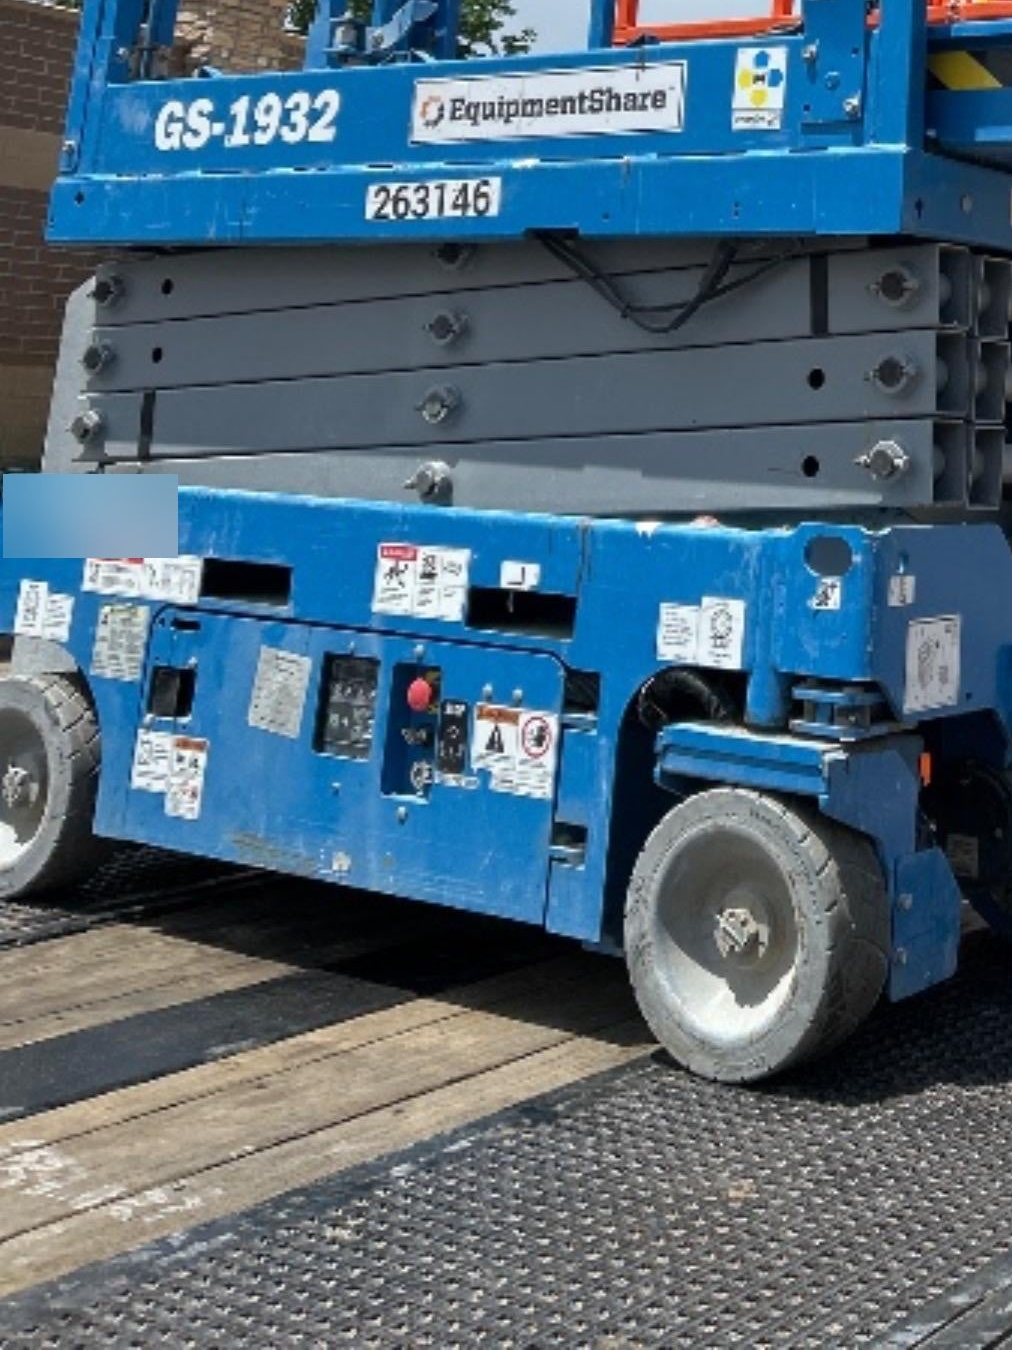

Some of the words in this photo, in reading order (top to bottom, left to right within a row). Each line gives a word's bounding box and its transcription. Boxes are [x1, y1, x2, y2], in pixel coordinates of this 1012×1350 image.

[155, 89, 340, 151] GS-1932
[448, 87, 667, 126] EquipmentShare
[372, 179, 491, 220] 263146
